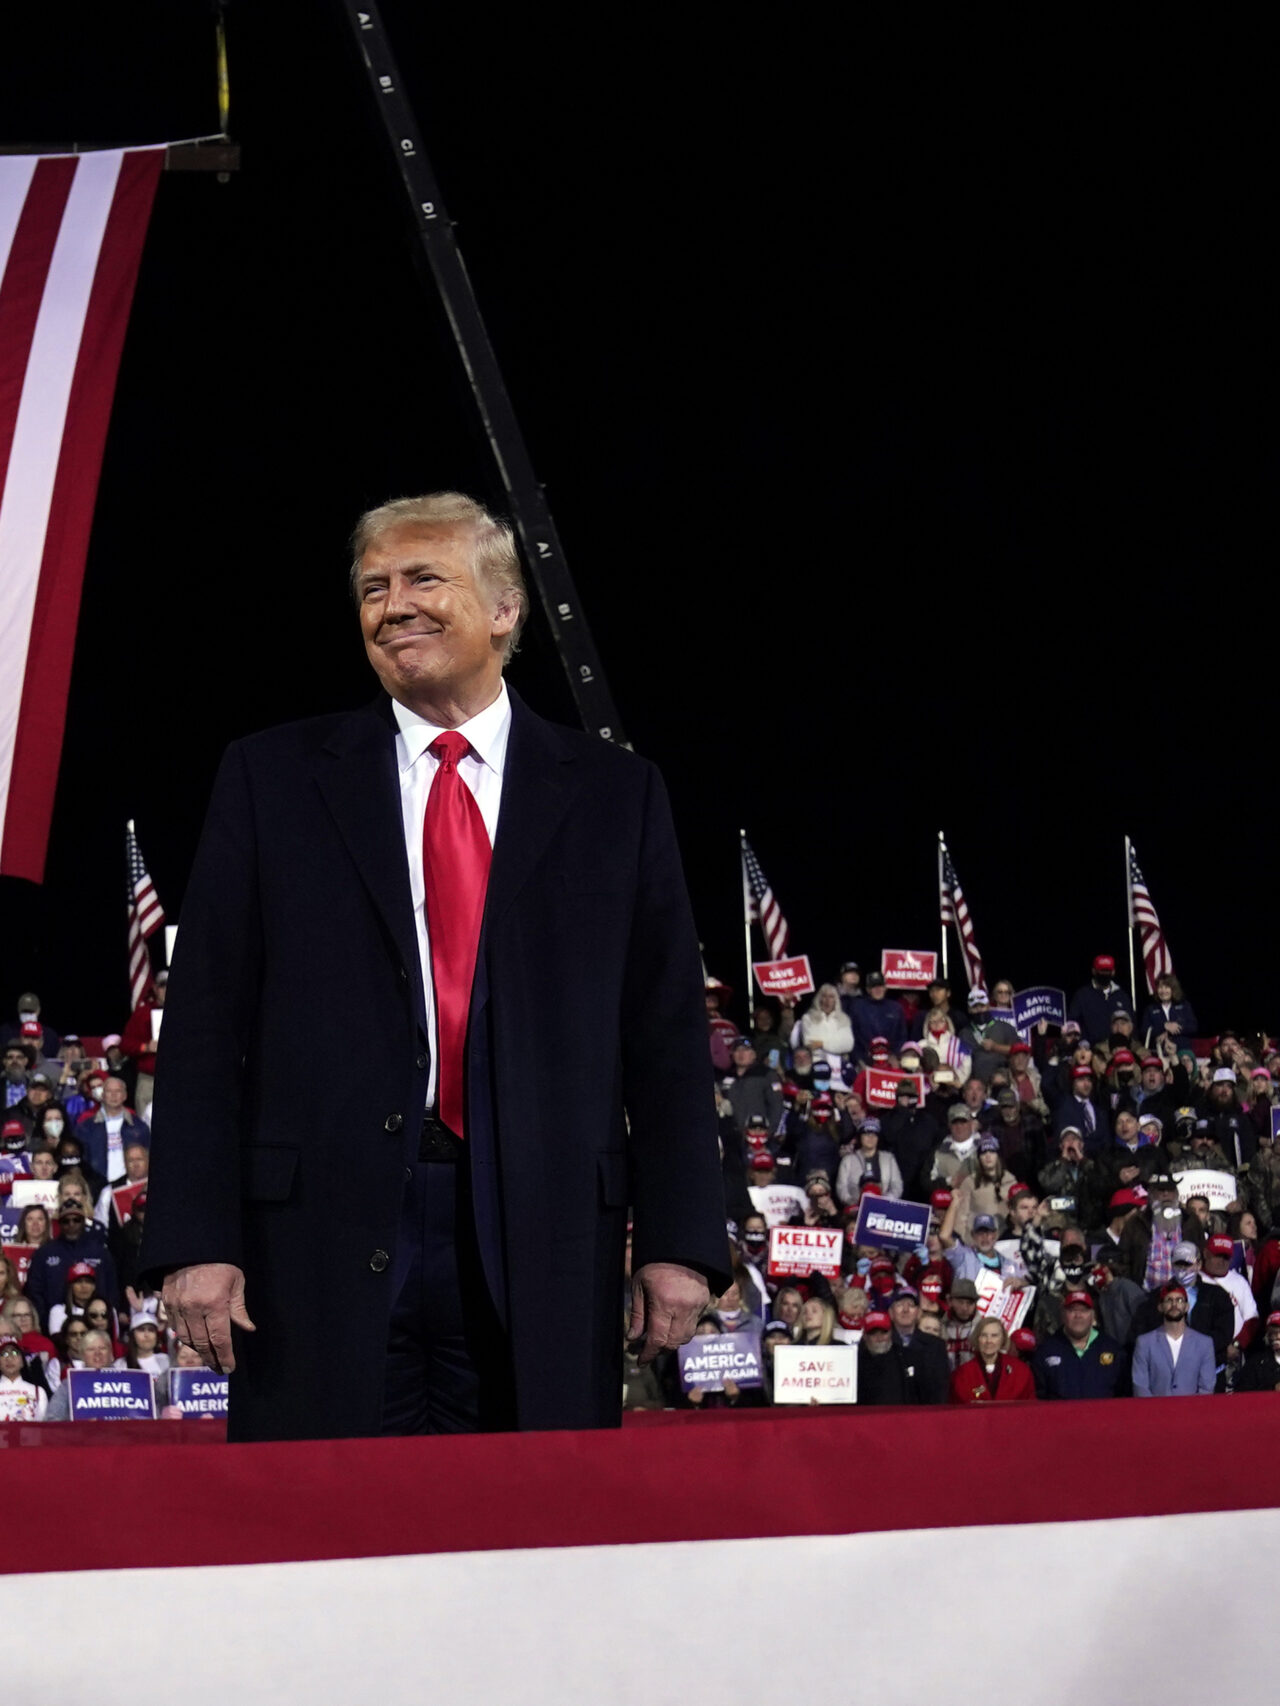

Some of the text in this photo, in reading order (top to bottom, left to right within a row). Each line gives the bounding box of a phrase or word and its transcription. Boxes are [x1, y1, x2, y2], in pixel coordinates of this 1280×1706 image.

[1025, 995, 1051, 1008] SAVE
[1017, 1005, 1062, 1024] AMERICA!
[866, 1216, 923, 1236] PERDUE
[777, 1231, 837, 1248] KELLY
[702, 1342, 735, 1354] MAKE
[684, 1352, 757, 1371] AMERICA
[799, 1361, 834, 1372] SAVE
[684, 1368, 759, 1383] GREAT AGAIN
[93, 1381, 132, 1394] SAVE
[781, 1377, 851, 1388] AMERICA!
[76, 1397, 150, 1410] AMERICA!
